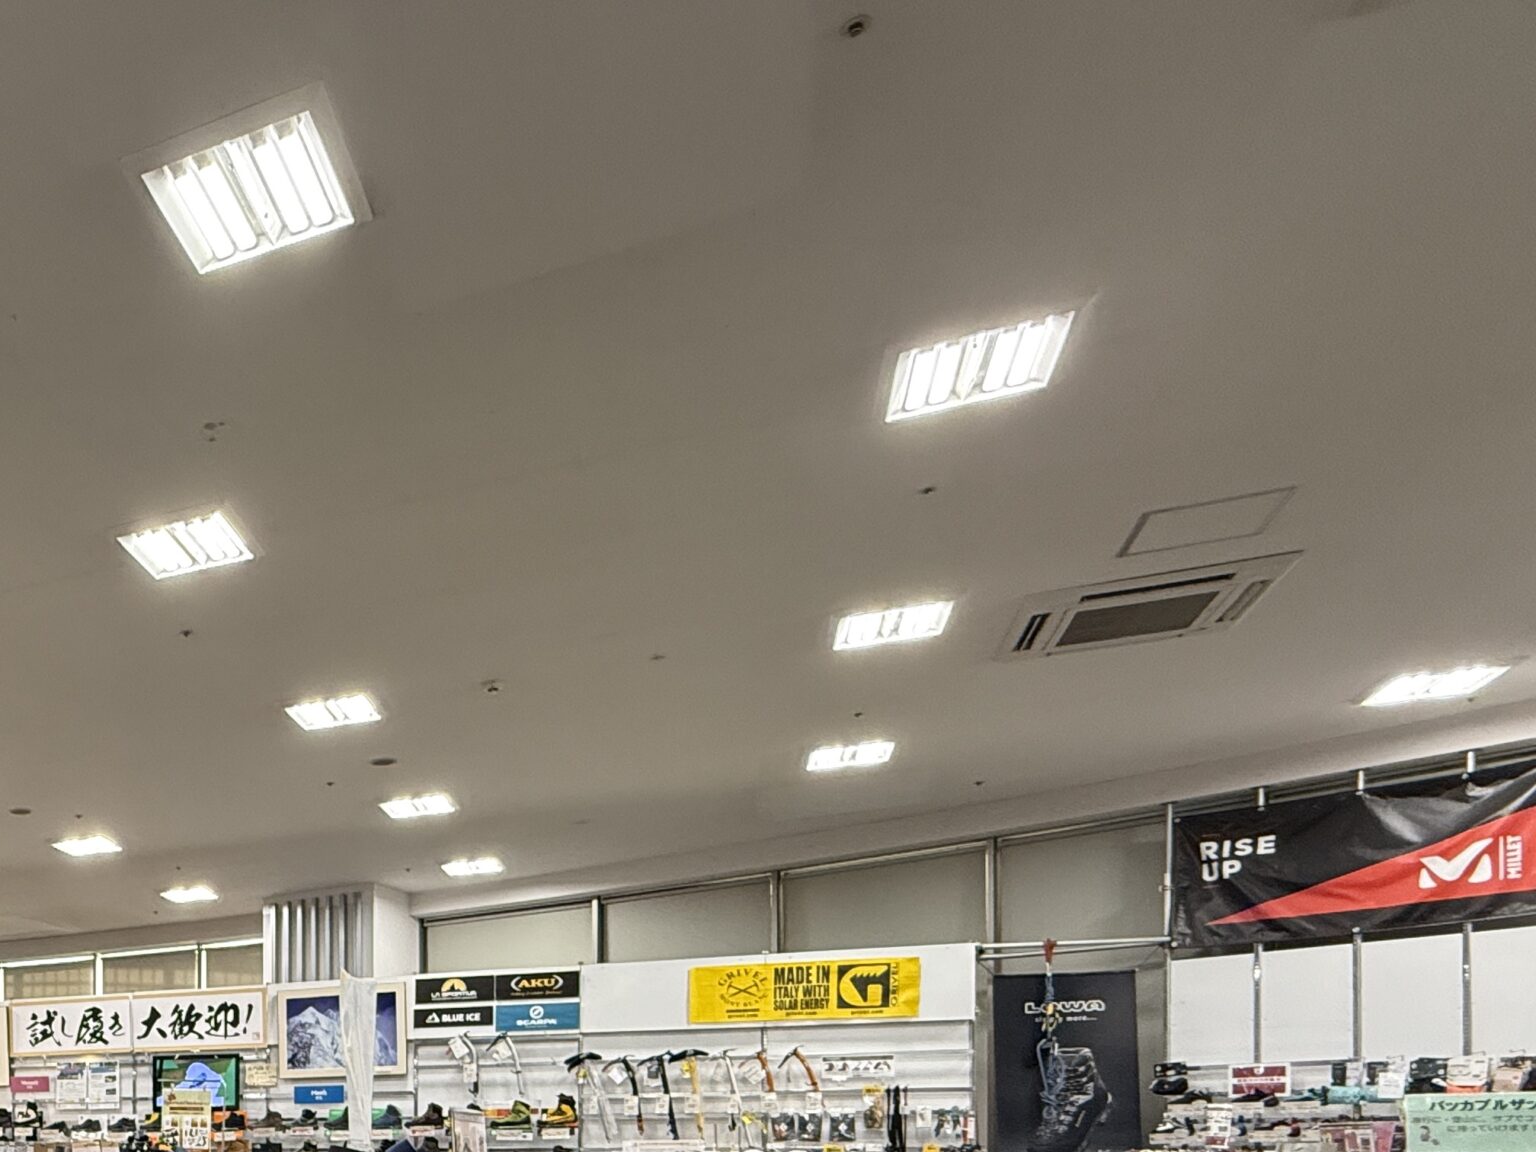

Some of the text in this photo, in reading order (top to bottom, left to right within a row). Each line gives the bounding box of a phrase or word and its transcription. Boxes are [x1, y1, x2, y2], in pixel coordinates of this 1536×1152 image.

[1200, 835, 1276, 860] RISE
[1506, 835, 1522, 879] MILLET
[1202, 860, 1242, 881] UP
[518, 978, 555, 988] AKU
[774, 965, 830, 986] MADE IN
[774, 984, 830, 999] ITALY WITH
[773, 998, 830, 1011] SOLAR ENERGY
[26, 1001, 253, 1047] 試し履き 大歓迎!
[441, 1012, 481, 1022] BLUE ICE
[516, 1018, 557, 1026] SCARPA
